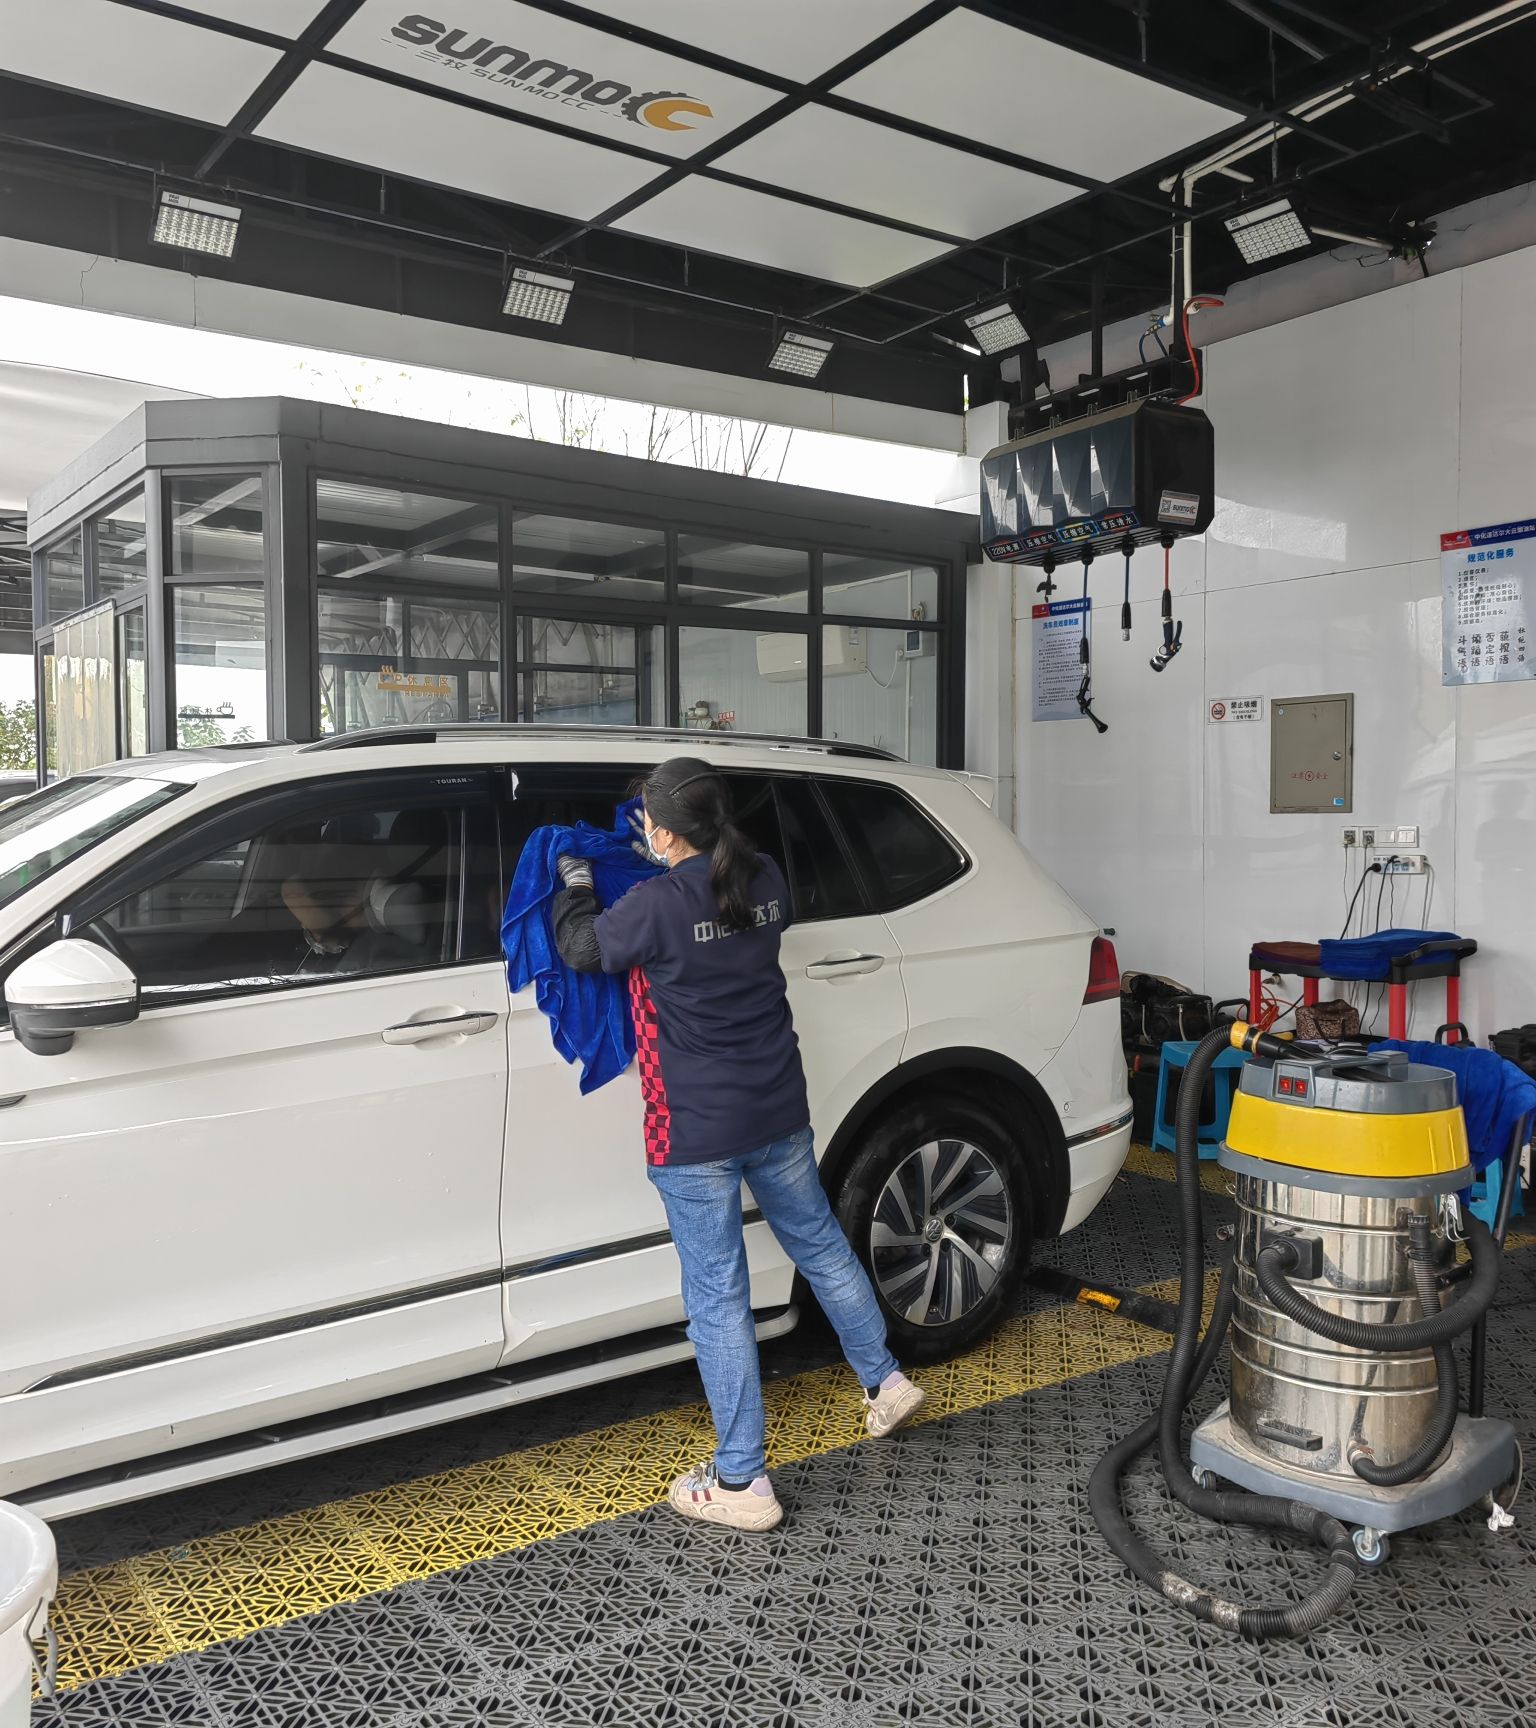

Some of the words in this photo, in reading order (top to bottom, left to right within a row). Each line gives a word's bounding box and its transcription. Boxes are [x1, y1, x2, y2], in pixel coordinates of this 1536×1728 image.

[415, 49, 467, 71] 三牧
[1467, 548, 1515, 563] 规范化服务
[407, 675, 448, 687] 休息区
[1231, 700, 1257, 709] 禁止吸烟
[694, 898, 781, 943] 中化达尔
